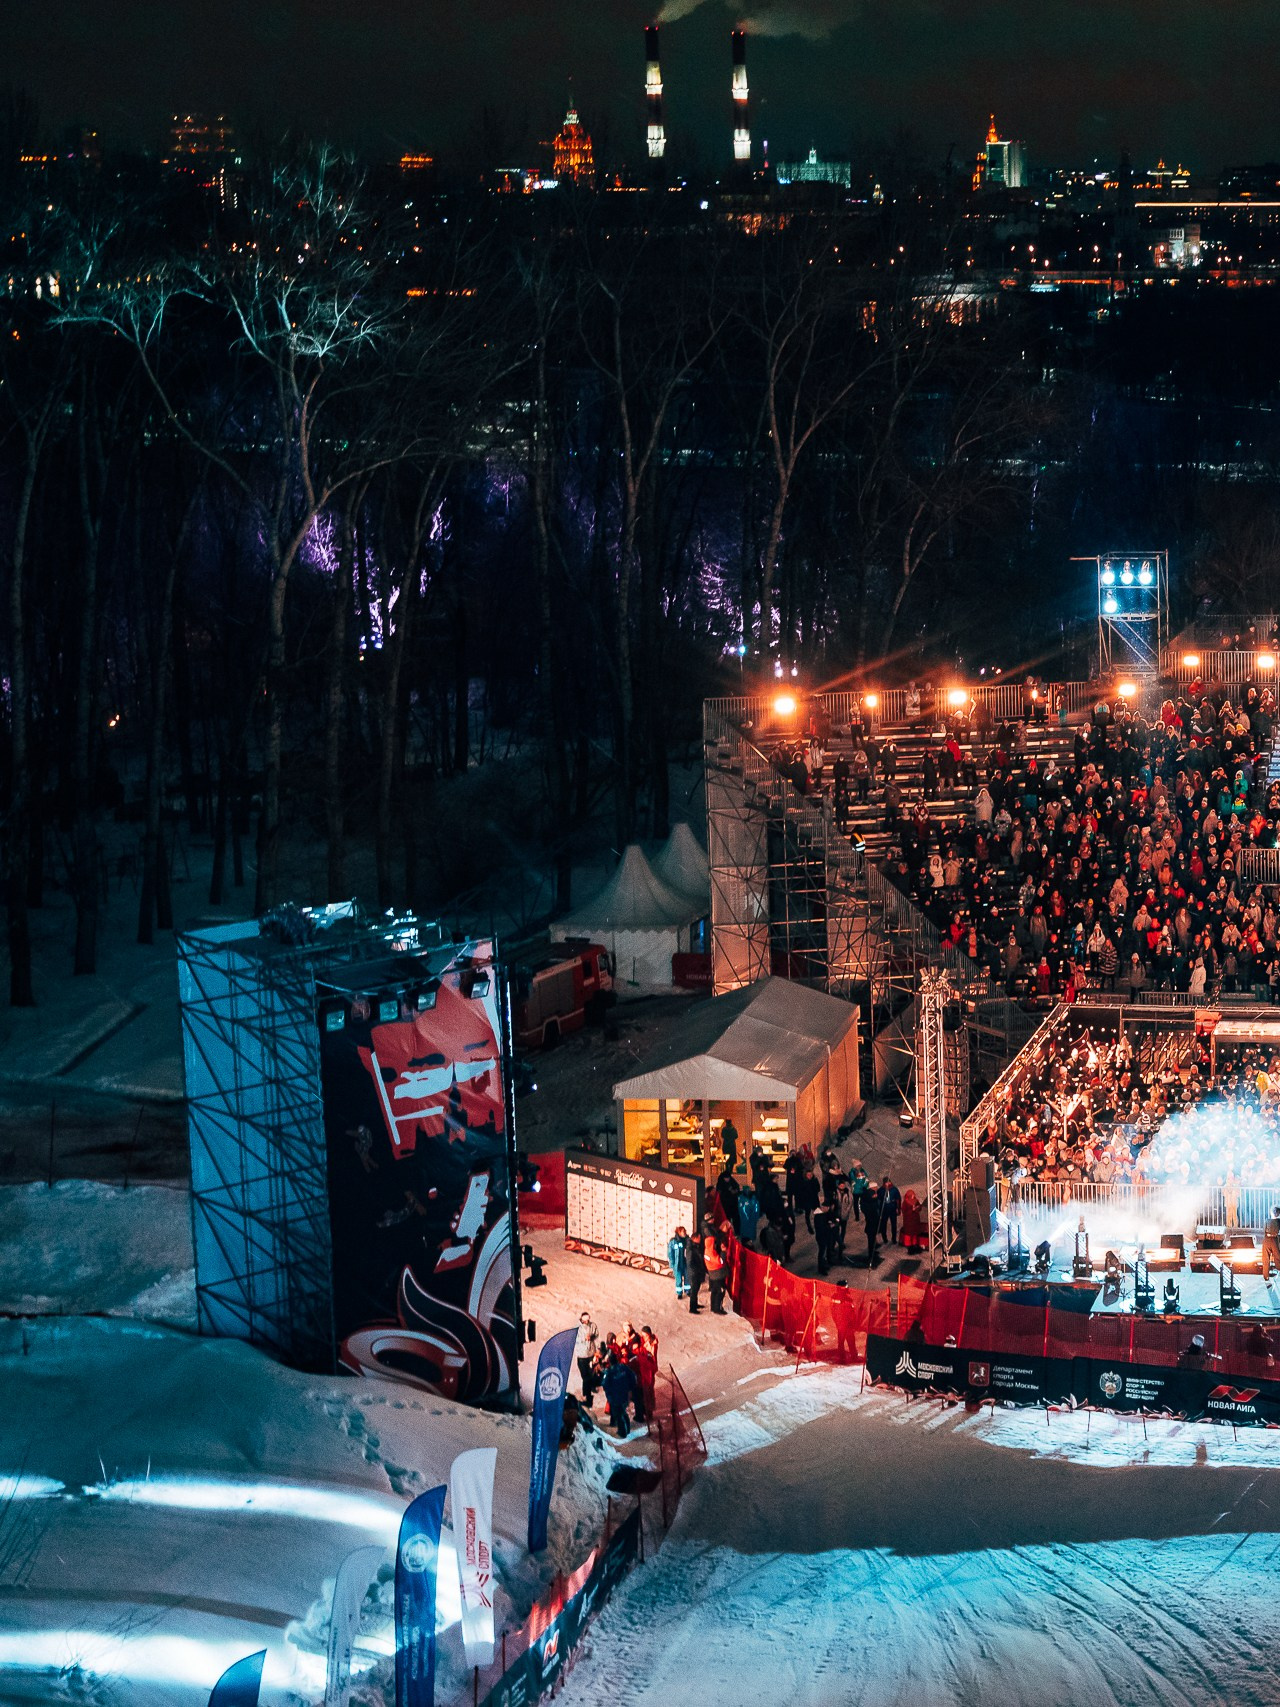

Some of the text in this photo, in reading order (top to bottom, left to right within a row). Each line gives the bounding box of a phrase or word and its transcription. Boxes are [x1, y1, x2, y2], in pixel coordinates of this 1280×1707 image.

[918, 1362, 953, 1373] МОСКОВСКИЙ
[993, 1365, 1033, 1375] Департамент
[918, 1371, 934, 1380] СПОРТ
[993, 1380, 1039, 1390] города Москвы
[1208, 1401, 1256, 1413] НОВАЯ ЛИГА
